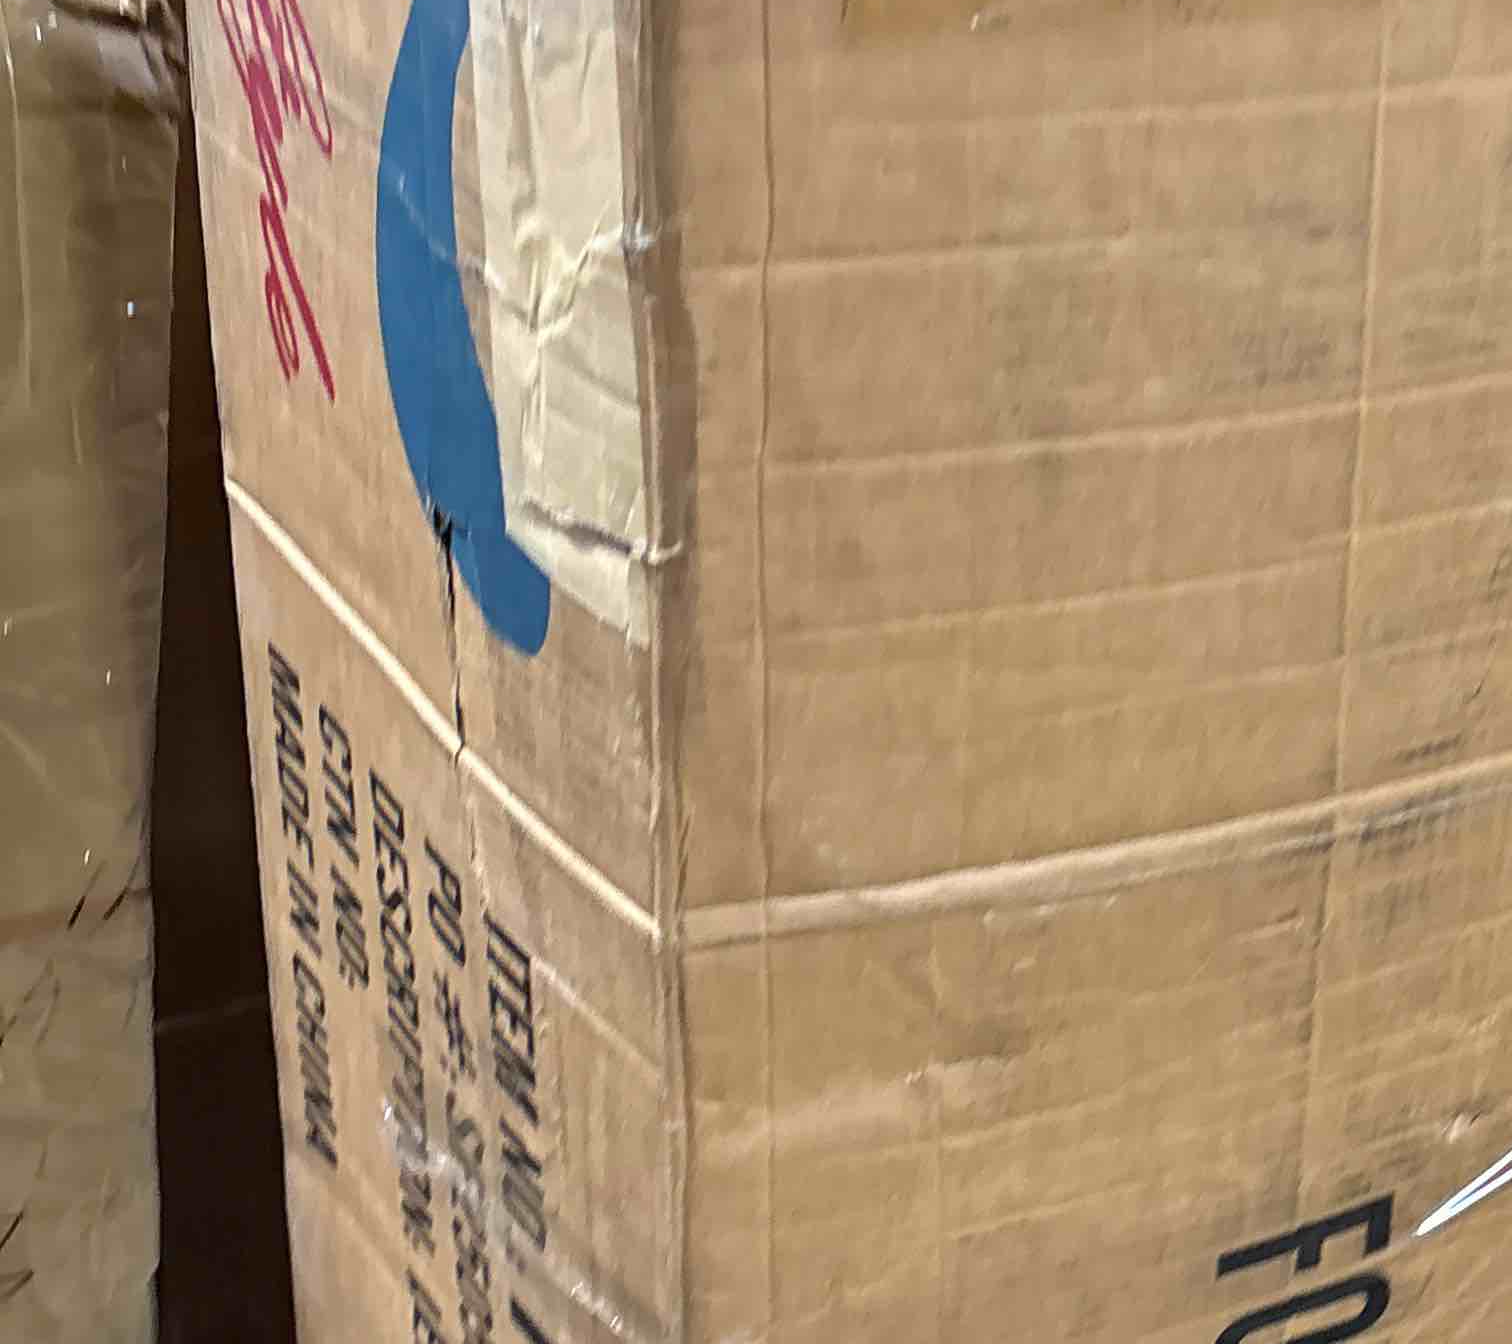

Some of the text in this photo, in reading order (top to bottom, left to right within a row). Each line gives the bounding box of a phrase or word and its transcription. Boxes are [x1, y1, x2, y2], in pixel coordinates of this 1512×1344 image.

[319, 704, 359, 868] CTN
[267, 641, 337, 1170] MADE IN CHINA
[423, 837, 466, 968] PO
[483, 909, 537, 1125] ITEM
